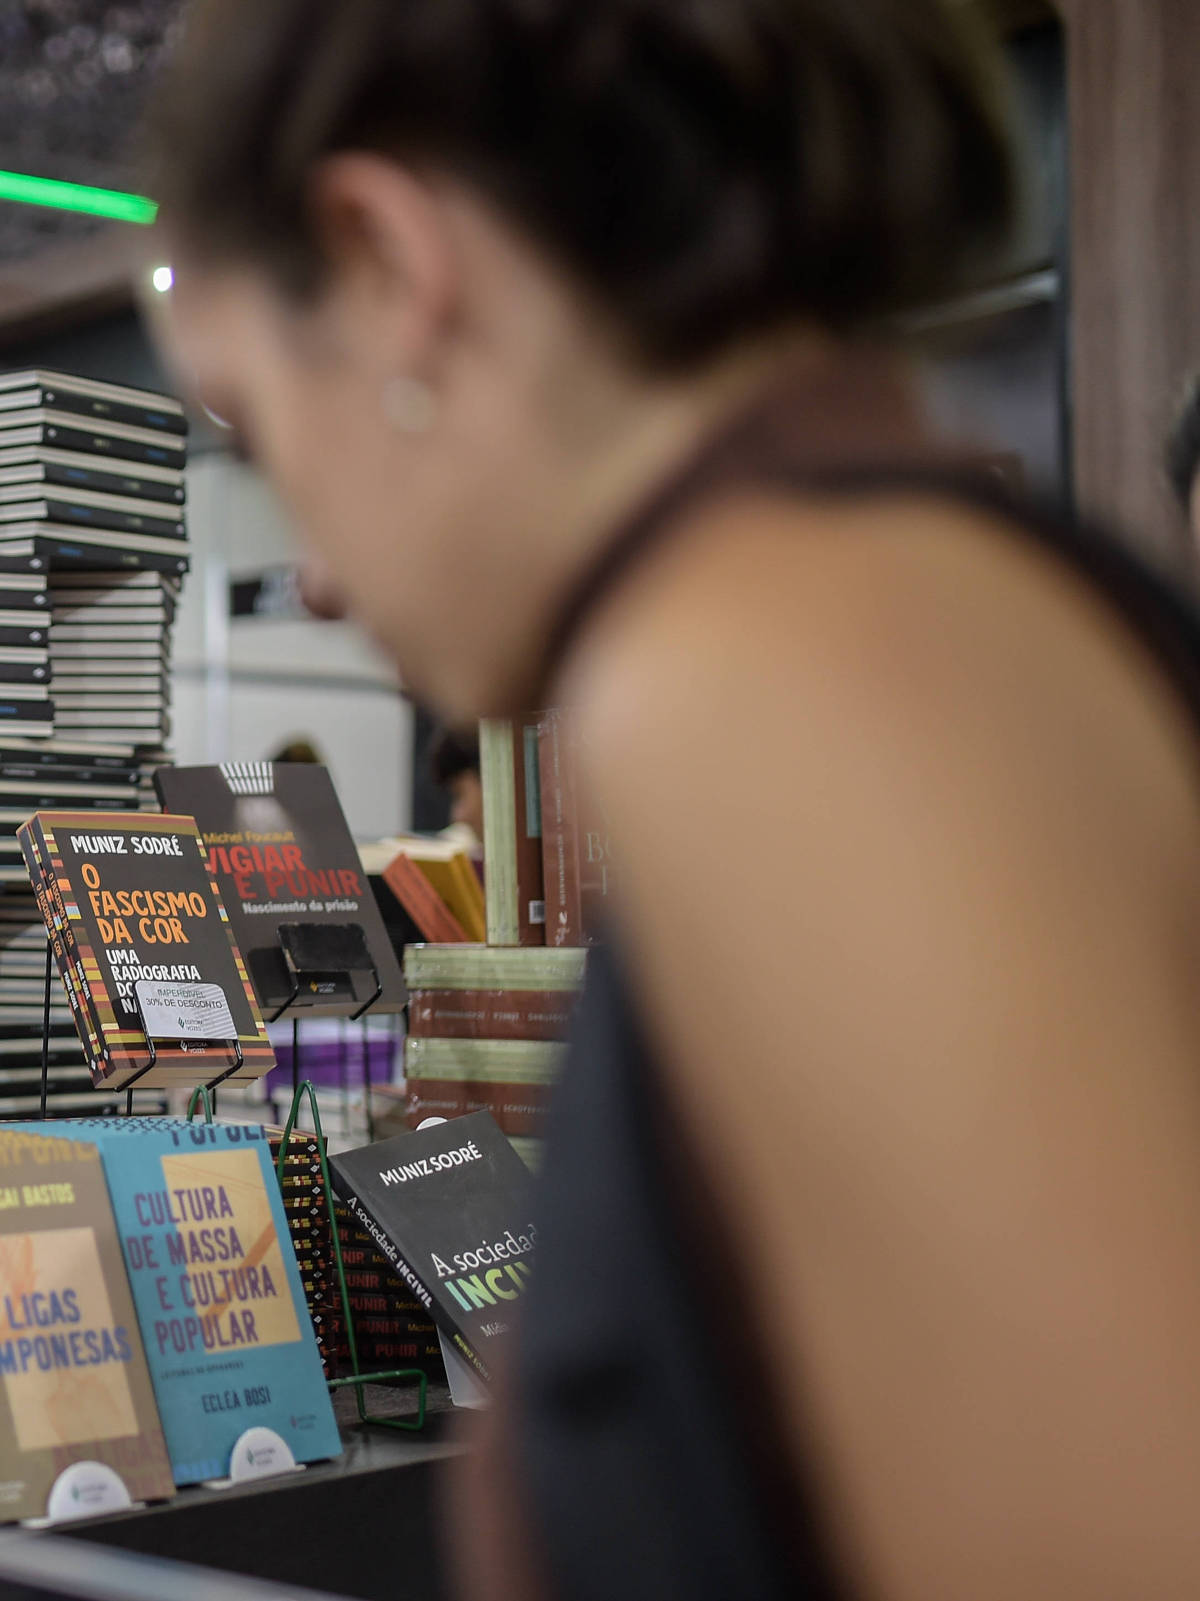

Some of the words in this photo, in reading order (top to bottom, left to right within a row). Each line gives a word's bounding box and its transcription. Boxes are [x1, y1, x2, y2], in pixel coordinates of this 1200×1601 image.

[70, 835, 128, 855] MUNIZ
[133, 835, 184, 857] SODRÉ
[209, 844, 307, 875] VIGIAR
[81, 863, 101, 890] O
[233, 872, 258, 899] E
[263, 868, 364, 898] PUNIR
[88, 890, 207, 918] FASCISMO
[242, 900, 307, 915] Nascimento
[96, 918, 134, 944] DA
[138, 918, 190, 944] COR
[105, 949, 140, 964] UMA
[110, 965, 201, 981] RADIOGRAFIA
[164, 998, 176, 1007] DE
[177, 999, 223, 1009] DESCONTO
[379, 1159, 431, 1187] MUNIZ
[430, 1140, 483, 1173] SODRÉ
[133, 1185, 234, 1228] CULTURA
[125, 1236, 160, 1272] DE
[166, 1226, 246, 1270] MASSA
[347, 1197, 358, 1210] A
[356, 1207, 398, 1261] sociedade
[396, 1259, 433, 1309] INCIVIL
[431, 1252, 456, 1278] A
[156, 1276, 174, 1311] E
[178, 1264, 278, 1309] CULTURA
[5, 1288, 81, 1331] LIGAS
[154, 1309, 260, 1356] POPULAR
[244, 1384, 273, 1407] BOSI
